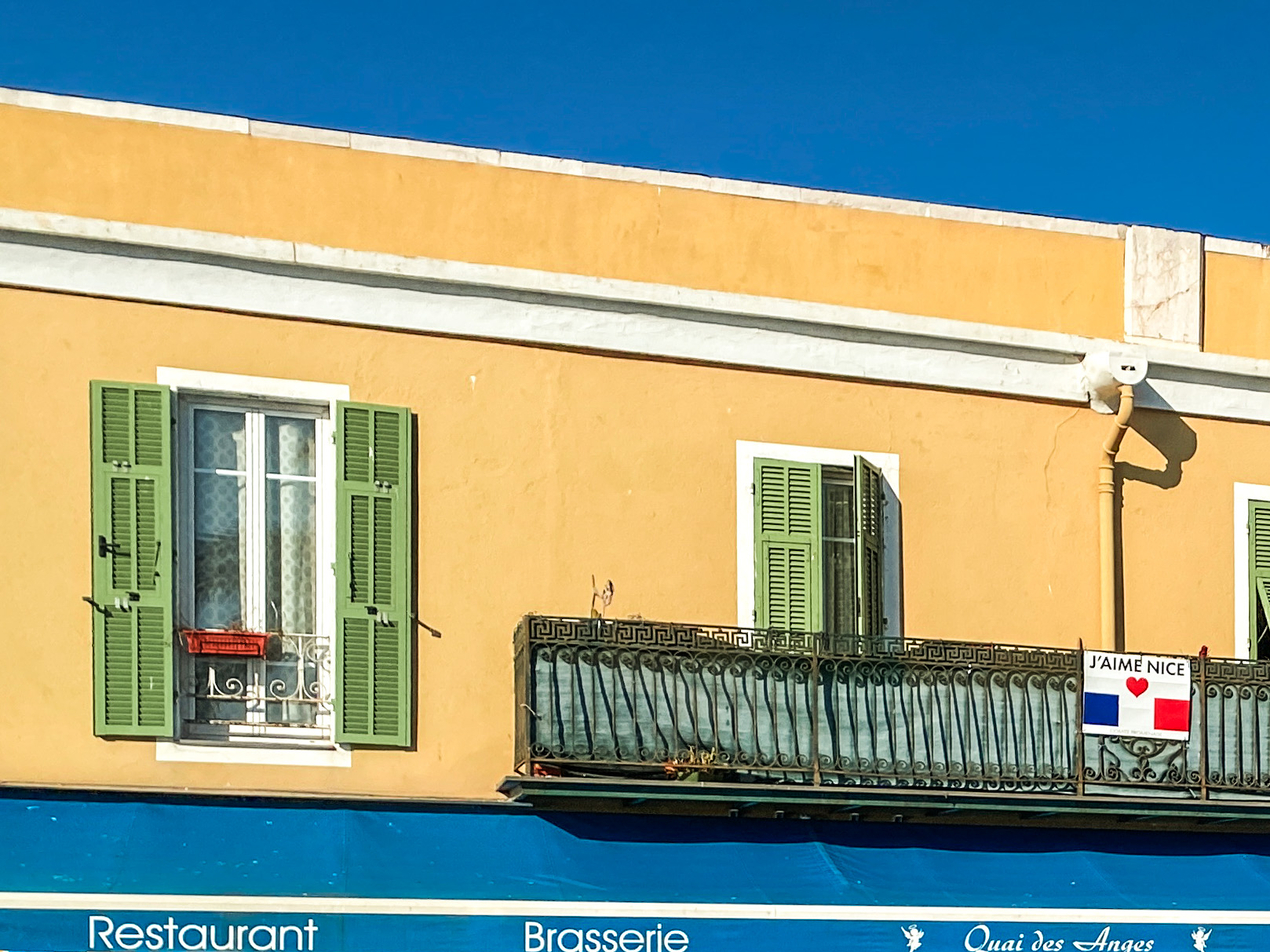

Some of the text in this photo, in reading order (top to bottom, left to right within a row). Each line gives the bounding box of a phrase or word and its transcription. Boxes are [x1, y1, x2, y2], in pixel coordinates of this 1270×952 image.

[1089, 655, 1185, 676] J'AIME NICE
[88, 915, 319, 951] Restaurant
[1031, 930, 1065, 952] des
